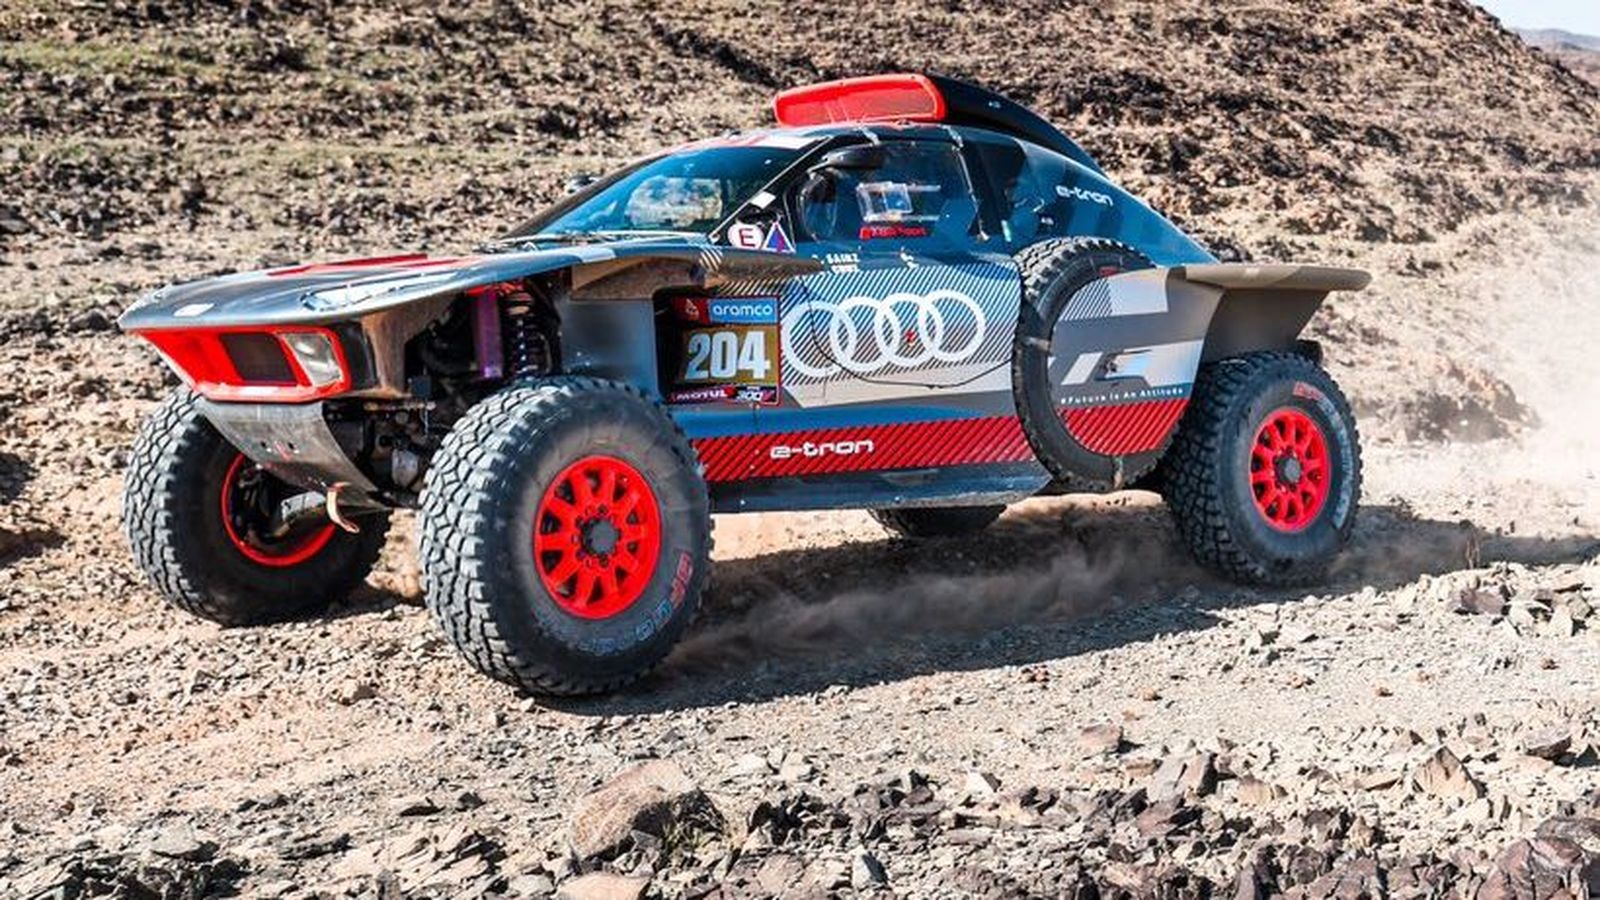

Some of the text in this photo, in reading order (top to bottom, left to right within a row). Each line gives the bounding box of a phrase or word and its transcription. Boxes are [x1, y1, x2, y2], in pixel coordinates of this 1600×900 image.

[1056, 185, 1114, 207] e-tron
[738, 227, 756, 248] E
[712, 304, 773, 316] aramco
[684, 331, 771, 380] 204
[676, 388, 728, 400] MOTUL
[769, 439, 874, 459] e-tron
